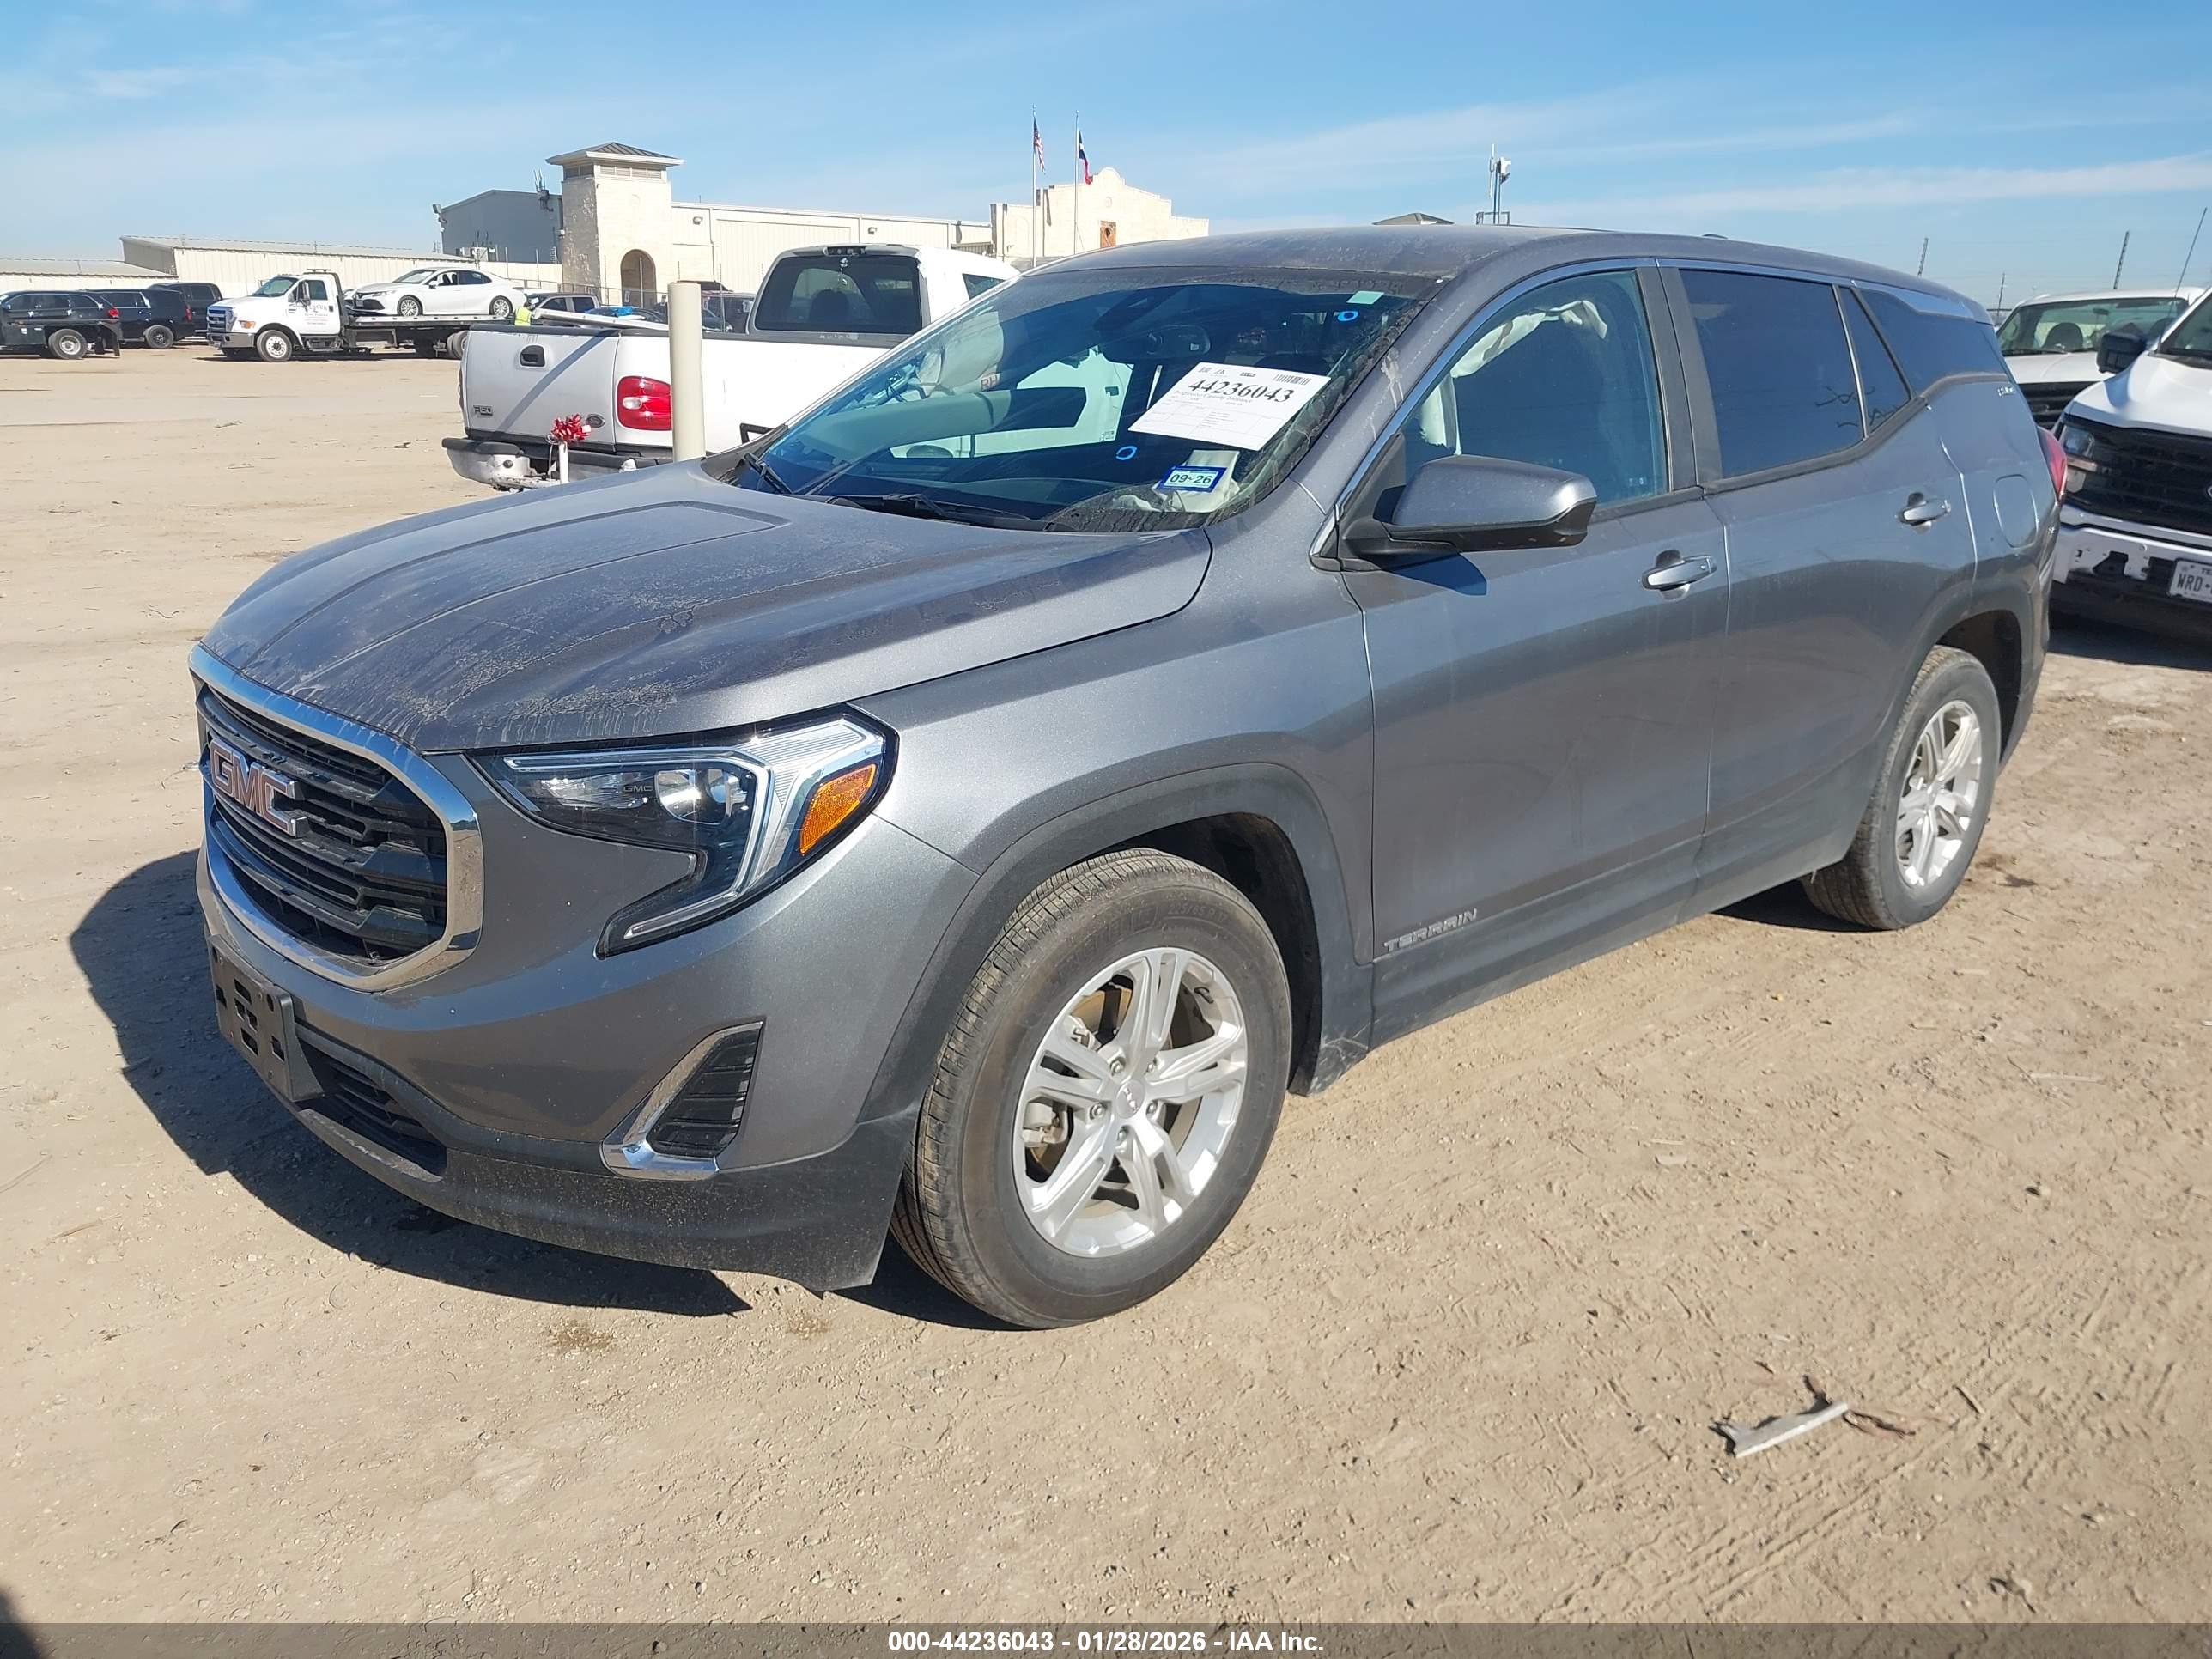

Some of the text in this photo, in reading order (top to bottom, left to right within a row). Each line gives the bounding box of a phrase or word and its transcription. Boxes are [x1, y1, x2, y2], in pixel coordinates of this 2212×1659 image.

[1188, 379, 1295, 402] 44236043
[211, 738, 301, 838] GMC
[1382, 908, 1477, 952] TERRAIN
